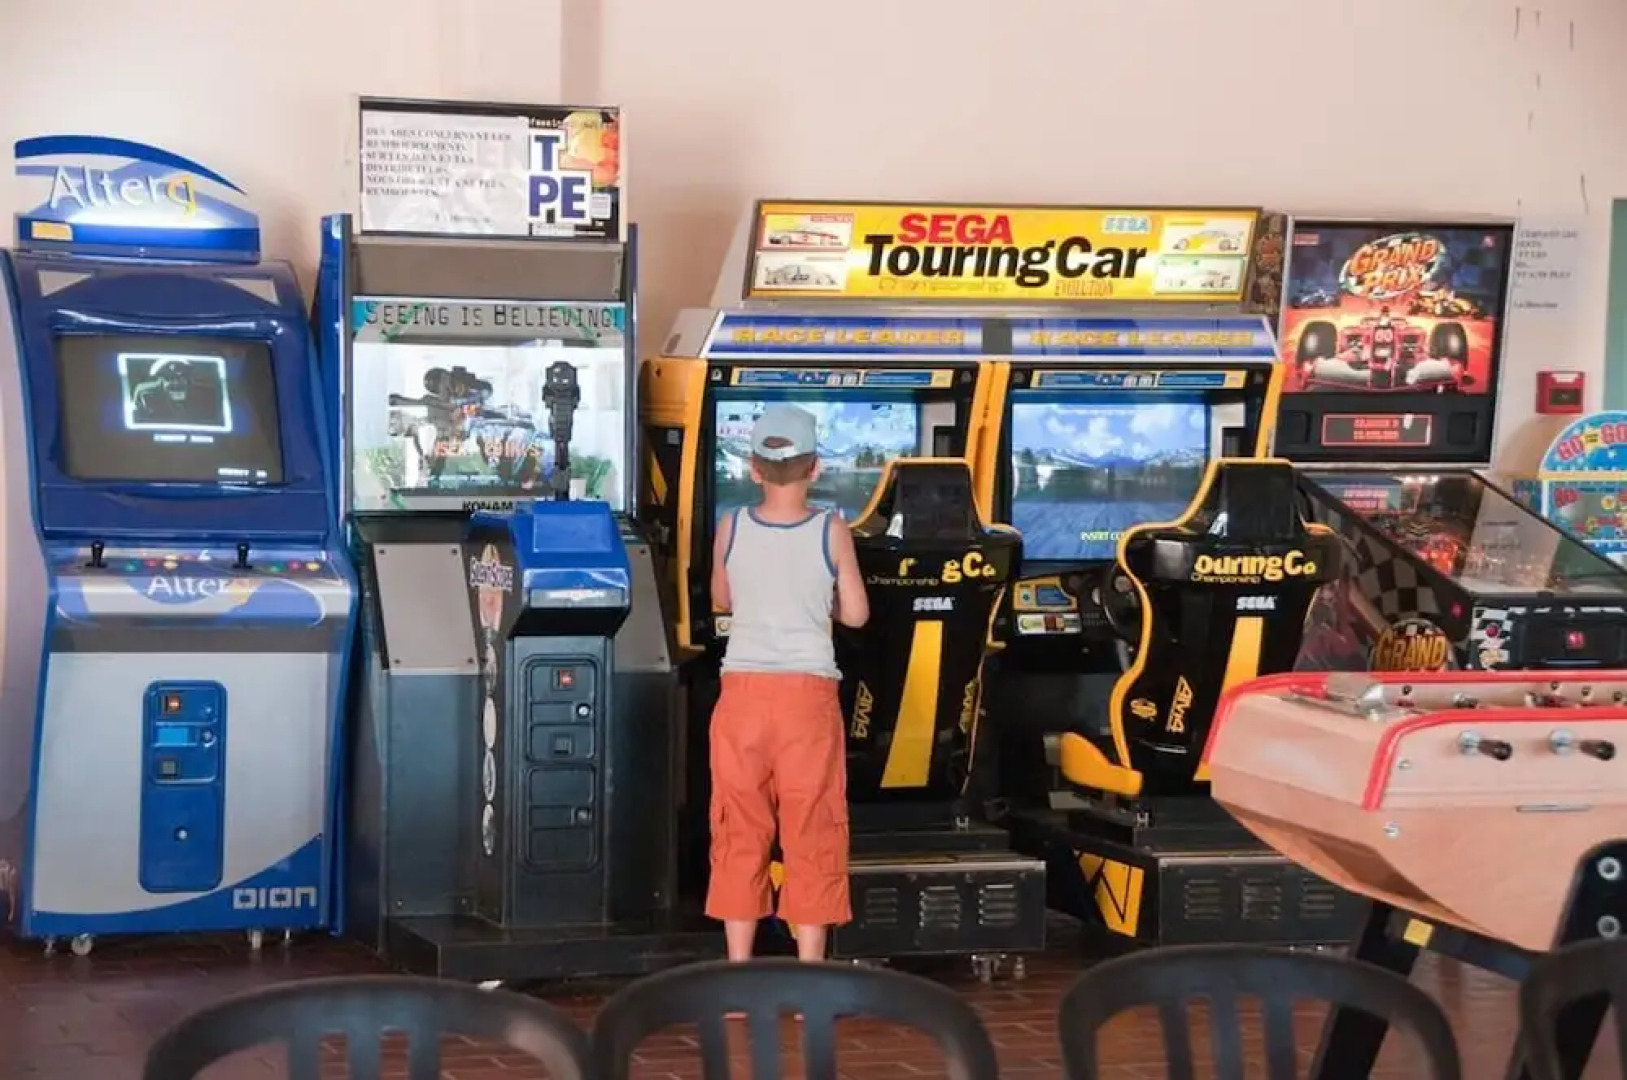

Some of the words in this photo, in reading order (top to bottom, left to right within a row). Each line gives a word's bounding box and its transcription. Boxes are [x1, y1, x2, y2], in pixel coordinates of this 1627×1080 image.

[897, 212, 1014, 245] SEGA
[1351, 239, 1438, 276] GRAND
[365, 300, 449, 326] SEEING
[461, 305, 483, 326] IS
[732, 326, 827, 345] RACE
[834, 327, 966, 346] LEADER
[462, 500, 514, 510] KONAM
[912, 596, 954, 612] SEGA
[1235, 595, 1276, 611] SEGA
